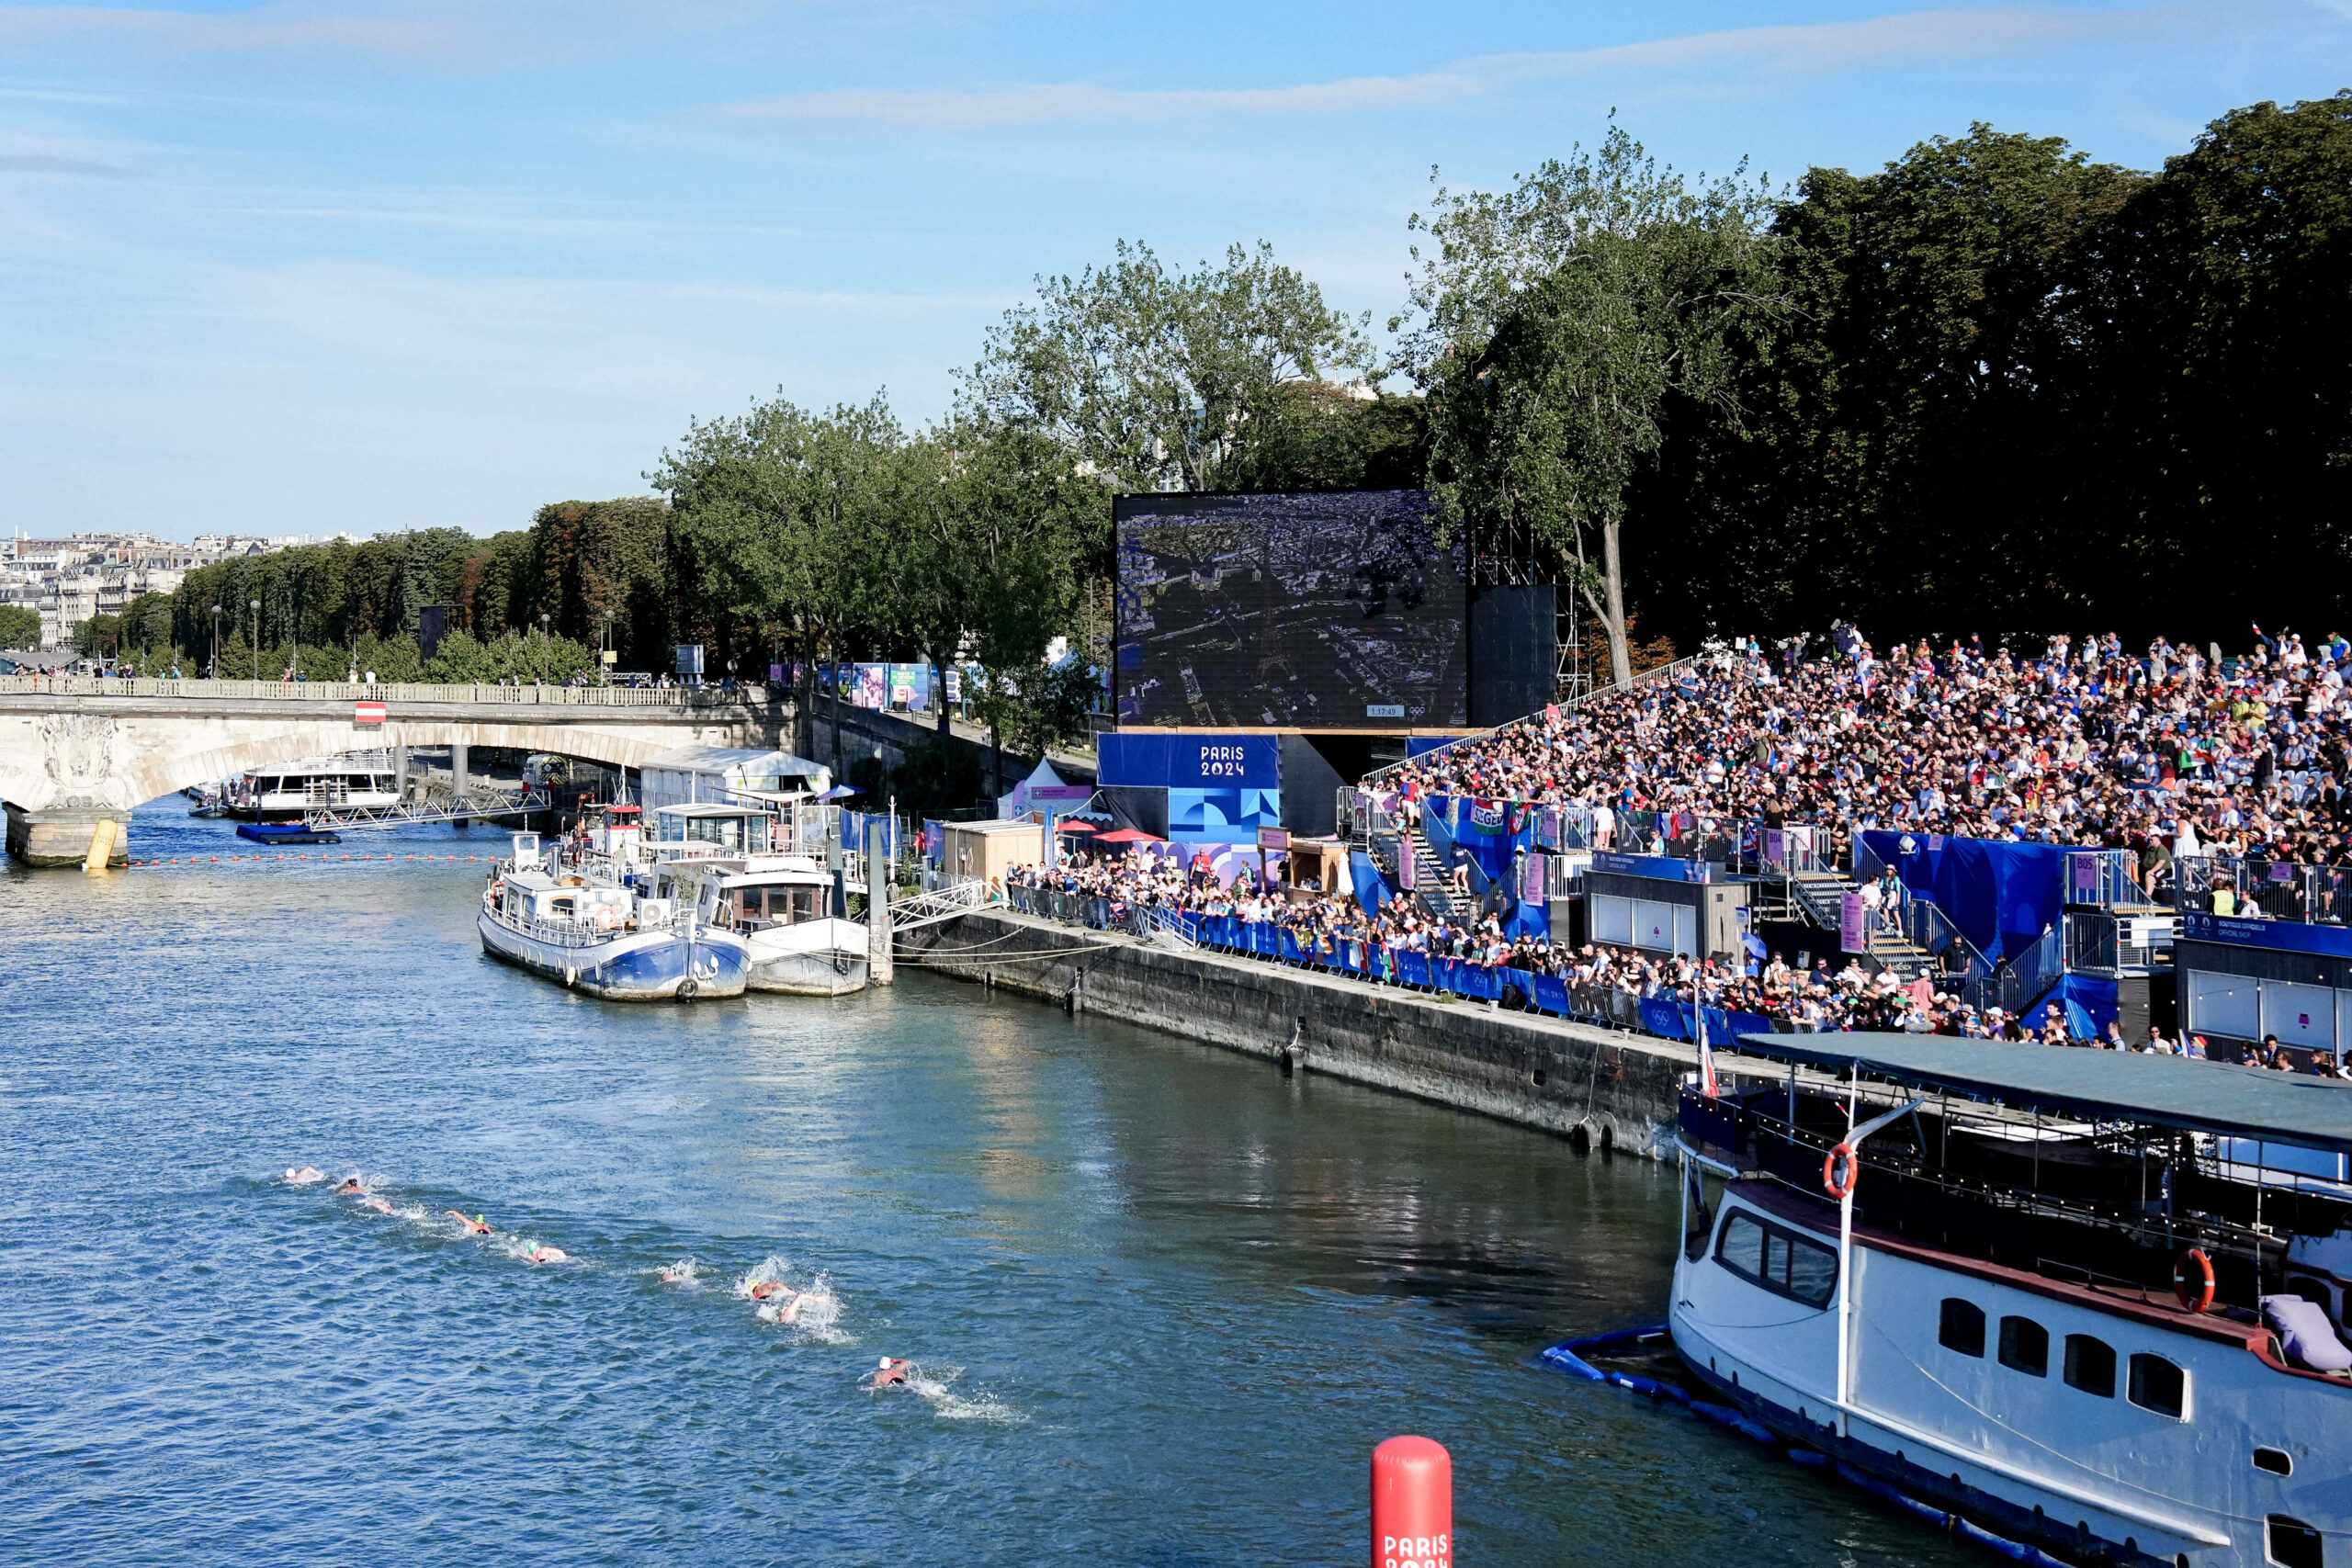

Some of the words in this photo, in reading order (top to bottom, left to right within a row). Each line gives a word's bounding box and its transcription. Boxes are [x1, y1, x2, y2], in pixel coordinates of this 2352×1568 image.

[1201, 762, 1243, 775] 2024
[1770, 832, 1781, 843] B04
[2077, 858, 2093, 870] B05
